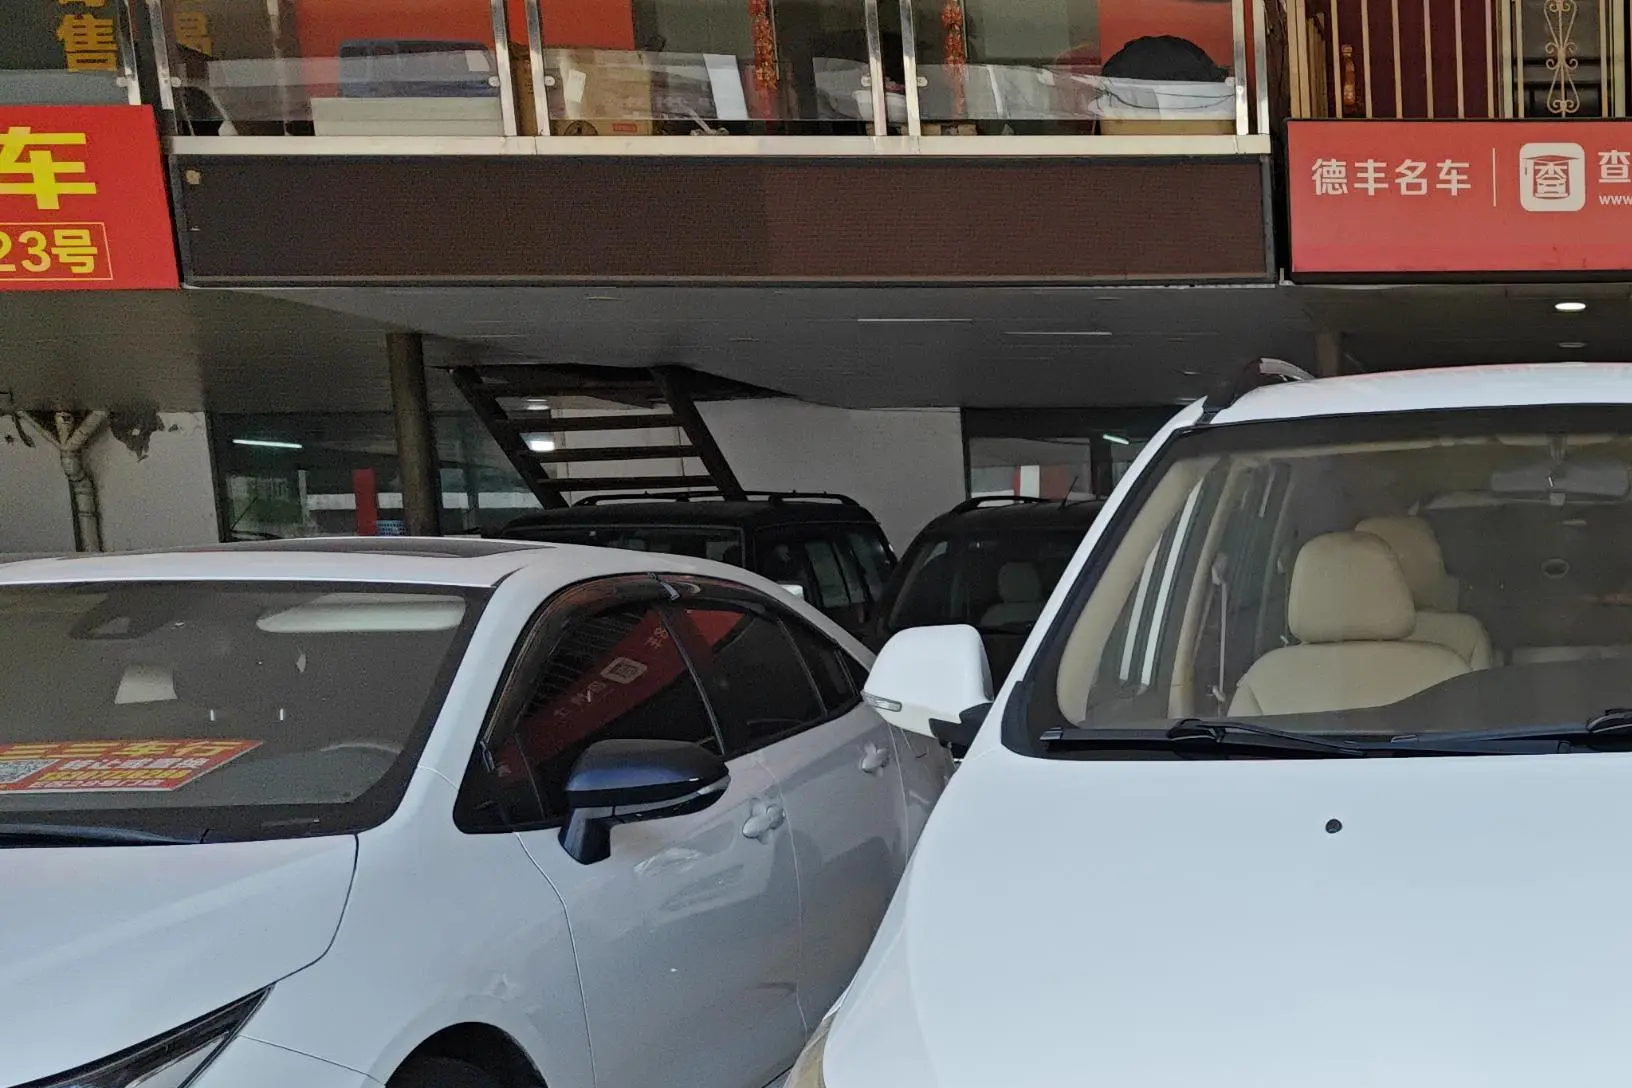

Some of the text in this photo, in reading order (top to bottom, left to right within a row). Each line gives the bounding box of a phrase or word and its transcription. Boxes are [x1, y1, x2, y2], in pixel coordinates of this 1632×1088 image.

[56, 0, 117, 72] 售
[0, 126, 97, 210] 车
[1312, 158, 1471, 196] 德丰名车
